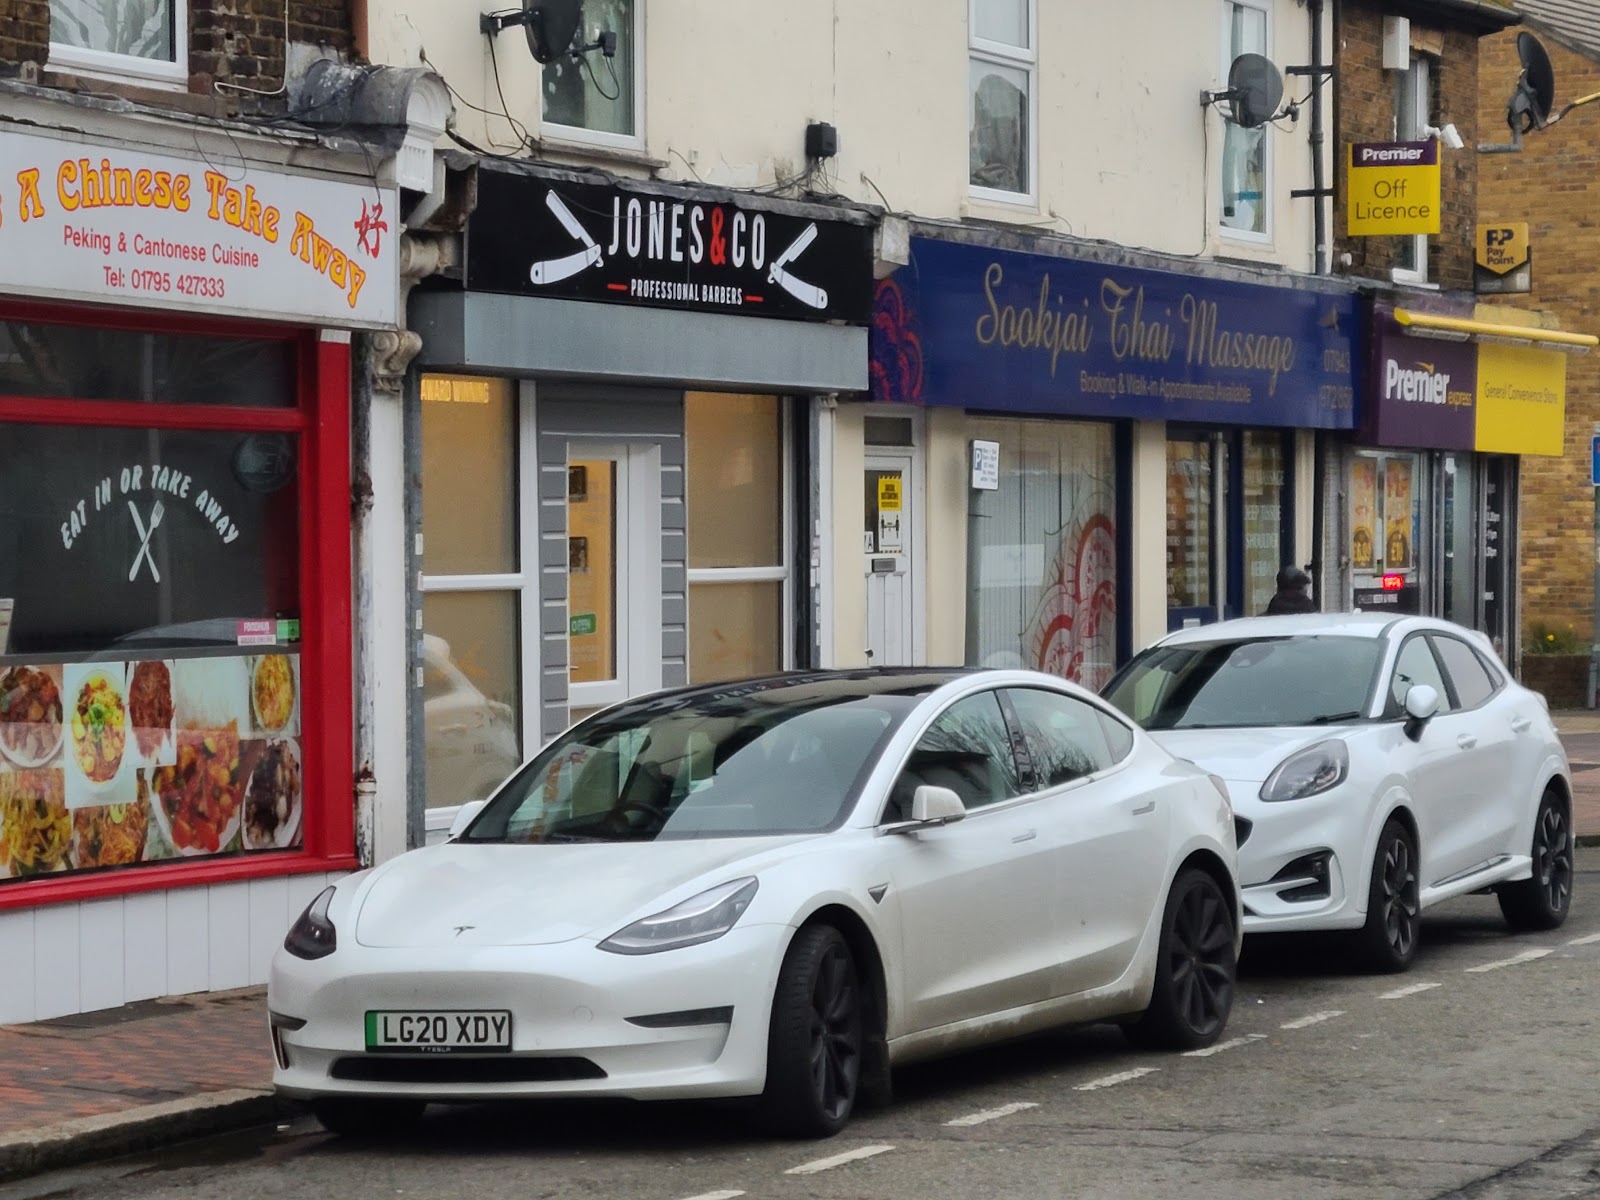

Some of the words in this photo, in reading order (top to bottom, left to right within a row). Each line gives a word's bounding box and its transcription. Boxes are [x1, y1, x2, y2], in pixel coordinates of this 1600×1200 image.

[1362, 147, 1424, 161] Premier
[1373, 178, 1408, 199] Off
[1355, 202, 1430, 220] Licence
[17, 167, 45, 222] A
[57, 158, 191, 211] Chinese
[205, 170, 280, 243] Take
[290, 211, 366, 308] Away
[354, 198, 388, 258] 好
[63, 225, 112, 255] Peking
[117, 231, 127, 253] &
[133, 234, 207, 263] Cantonese
[212, 243, 259, 268] Cuisine
[1487, 248, 1505, 257] Pay
[1487, 256, 1515, 265] Point
[103, 265, 126, 288] Tel:
[131, 269, 171, 292] 01795
[176, 274, 225, 298] 427333
[630, 278, 699, 302] PROFESSIONAL
[702, 285, 743, 305] BARBERS
[976, 263, 1095, 378] Sookjai
[1102, 278, 1175, 360] Thai
[1180, 293, 1297, 396] Massage
[1118, 373, 1125, 394] &
[1386, 359, 1450, 405] Premier
[60, 500, 87, 549] EAT
[95, 477, 112, 511] IN
[120, 464, 144, 494] OR
[151, 464, 192, 498] TAKE
[195, 489, 240, 544] AWAY
[383, 1016, 447, 1043] LG20
[456, 1016, 506, 1043] XDY
